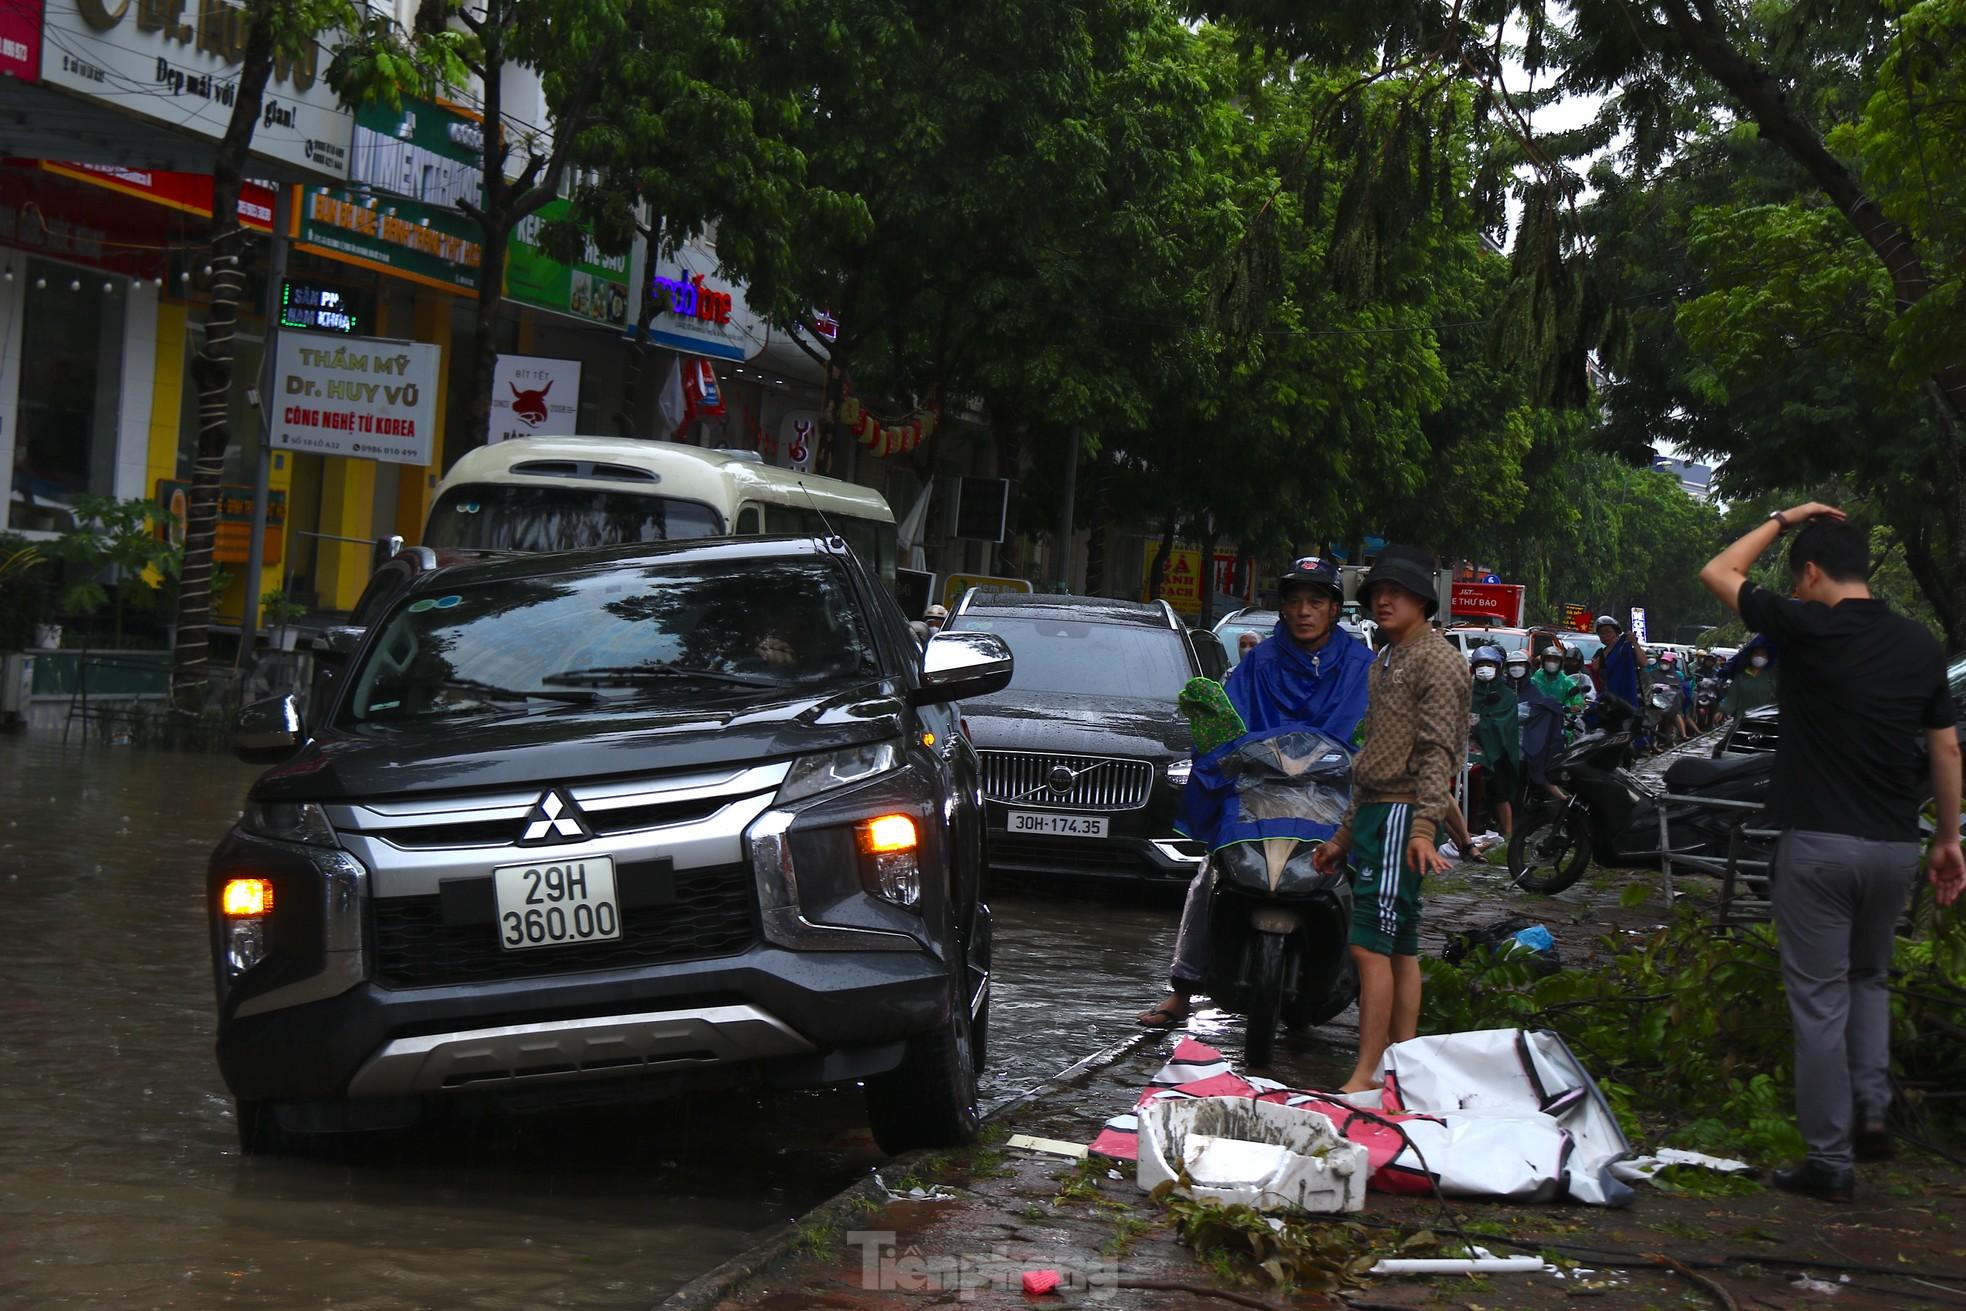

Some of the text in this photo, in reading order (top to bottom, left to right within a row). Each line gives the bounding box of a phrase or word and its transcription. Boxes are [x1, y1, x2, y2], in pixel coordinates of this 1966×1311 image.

[374, 354, 410, 376] MỸ
[286, 375, 419, 407] Dr. HUY VŨ
[285, 405, 415, 437] CÔNG NGHỆ TỪ KOREA
[1016, 815, 1101, 835] 30H-174.35
[523, 863, 588, 905] 29H
[502, 901, 617, 945] 360.00
